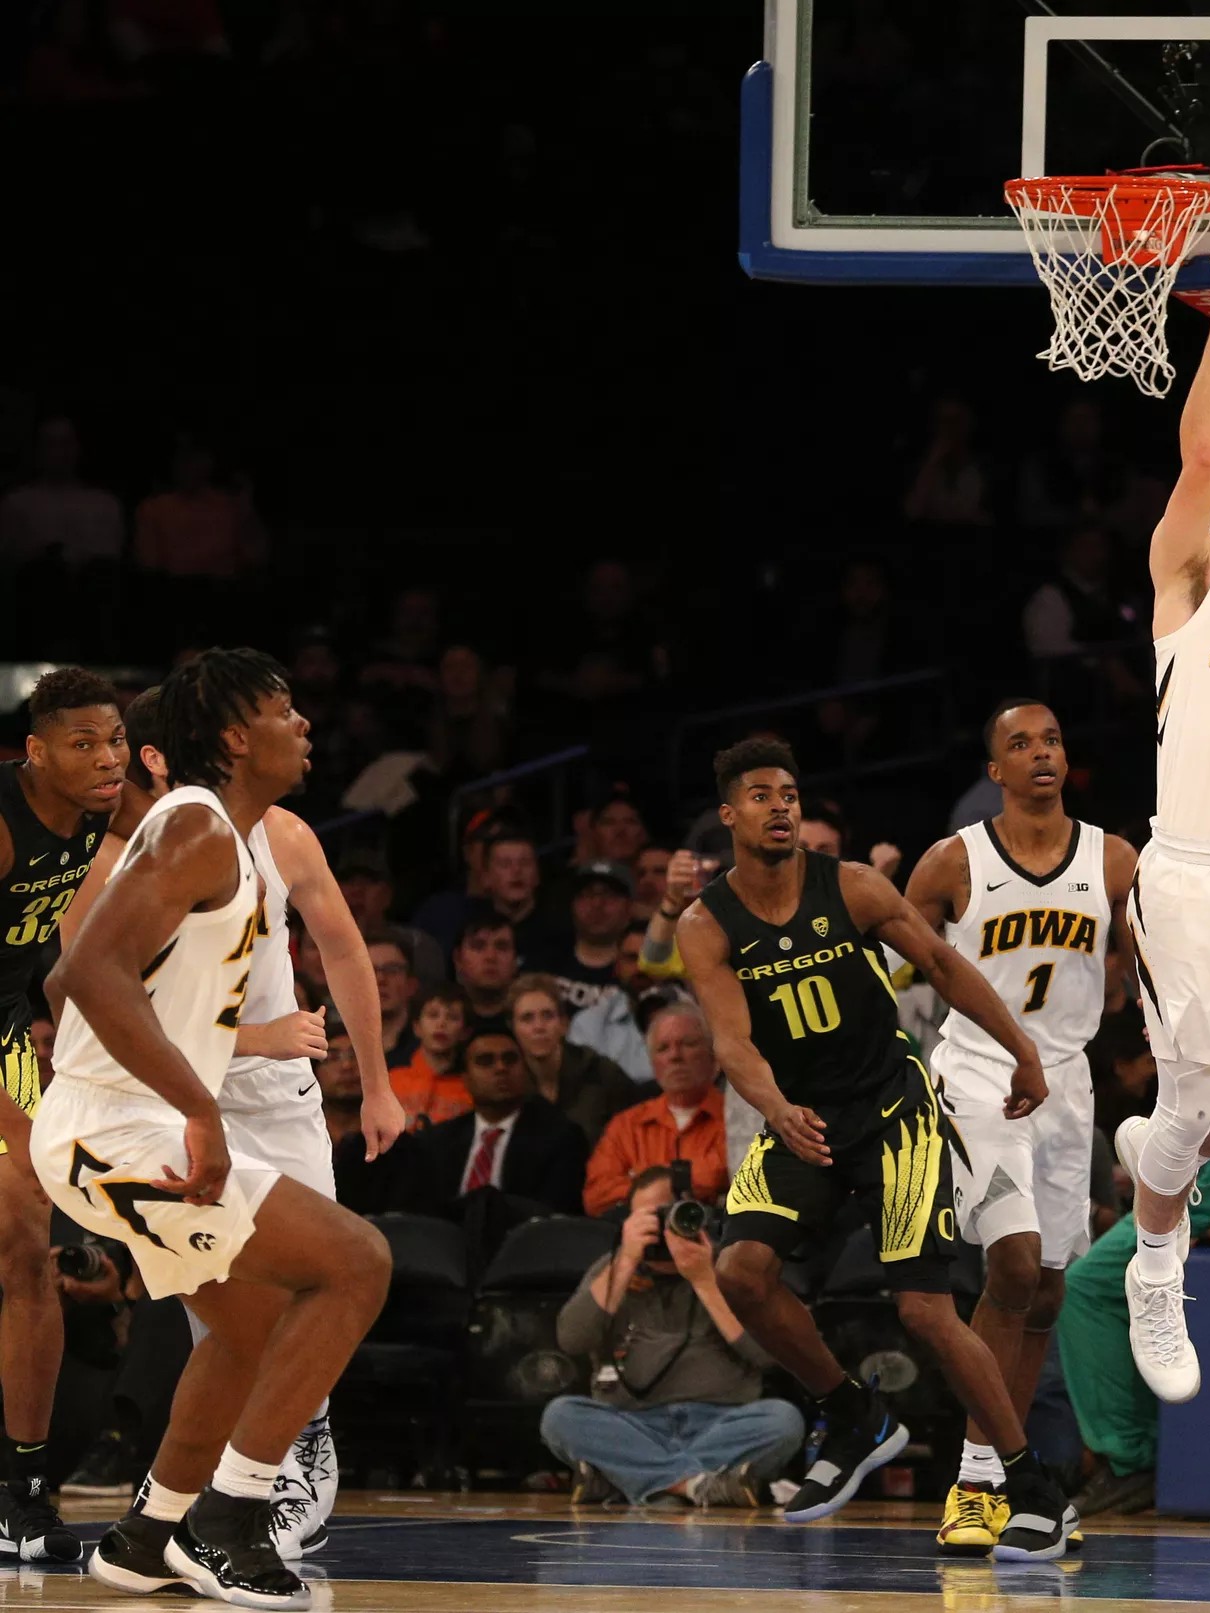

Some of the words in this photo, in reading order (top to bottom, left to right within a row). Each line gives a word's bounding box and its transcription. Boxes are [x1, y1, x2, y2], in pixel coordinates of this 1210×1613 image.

[5, 888, 76, 946] 33
[978, 908, 1098, 960] IOWA
[736, 941, 855, 981] OREGON
[1020, 961, 1057, 1016] 1
[768, 975, 841, 1040] 10
